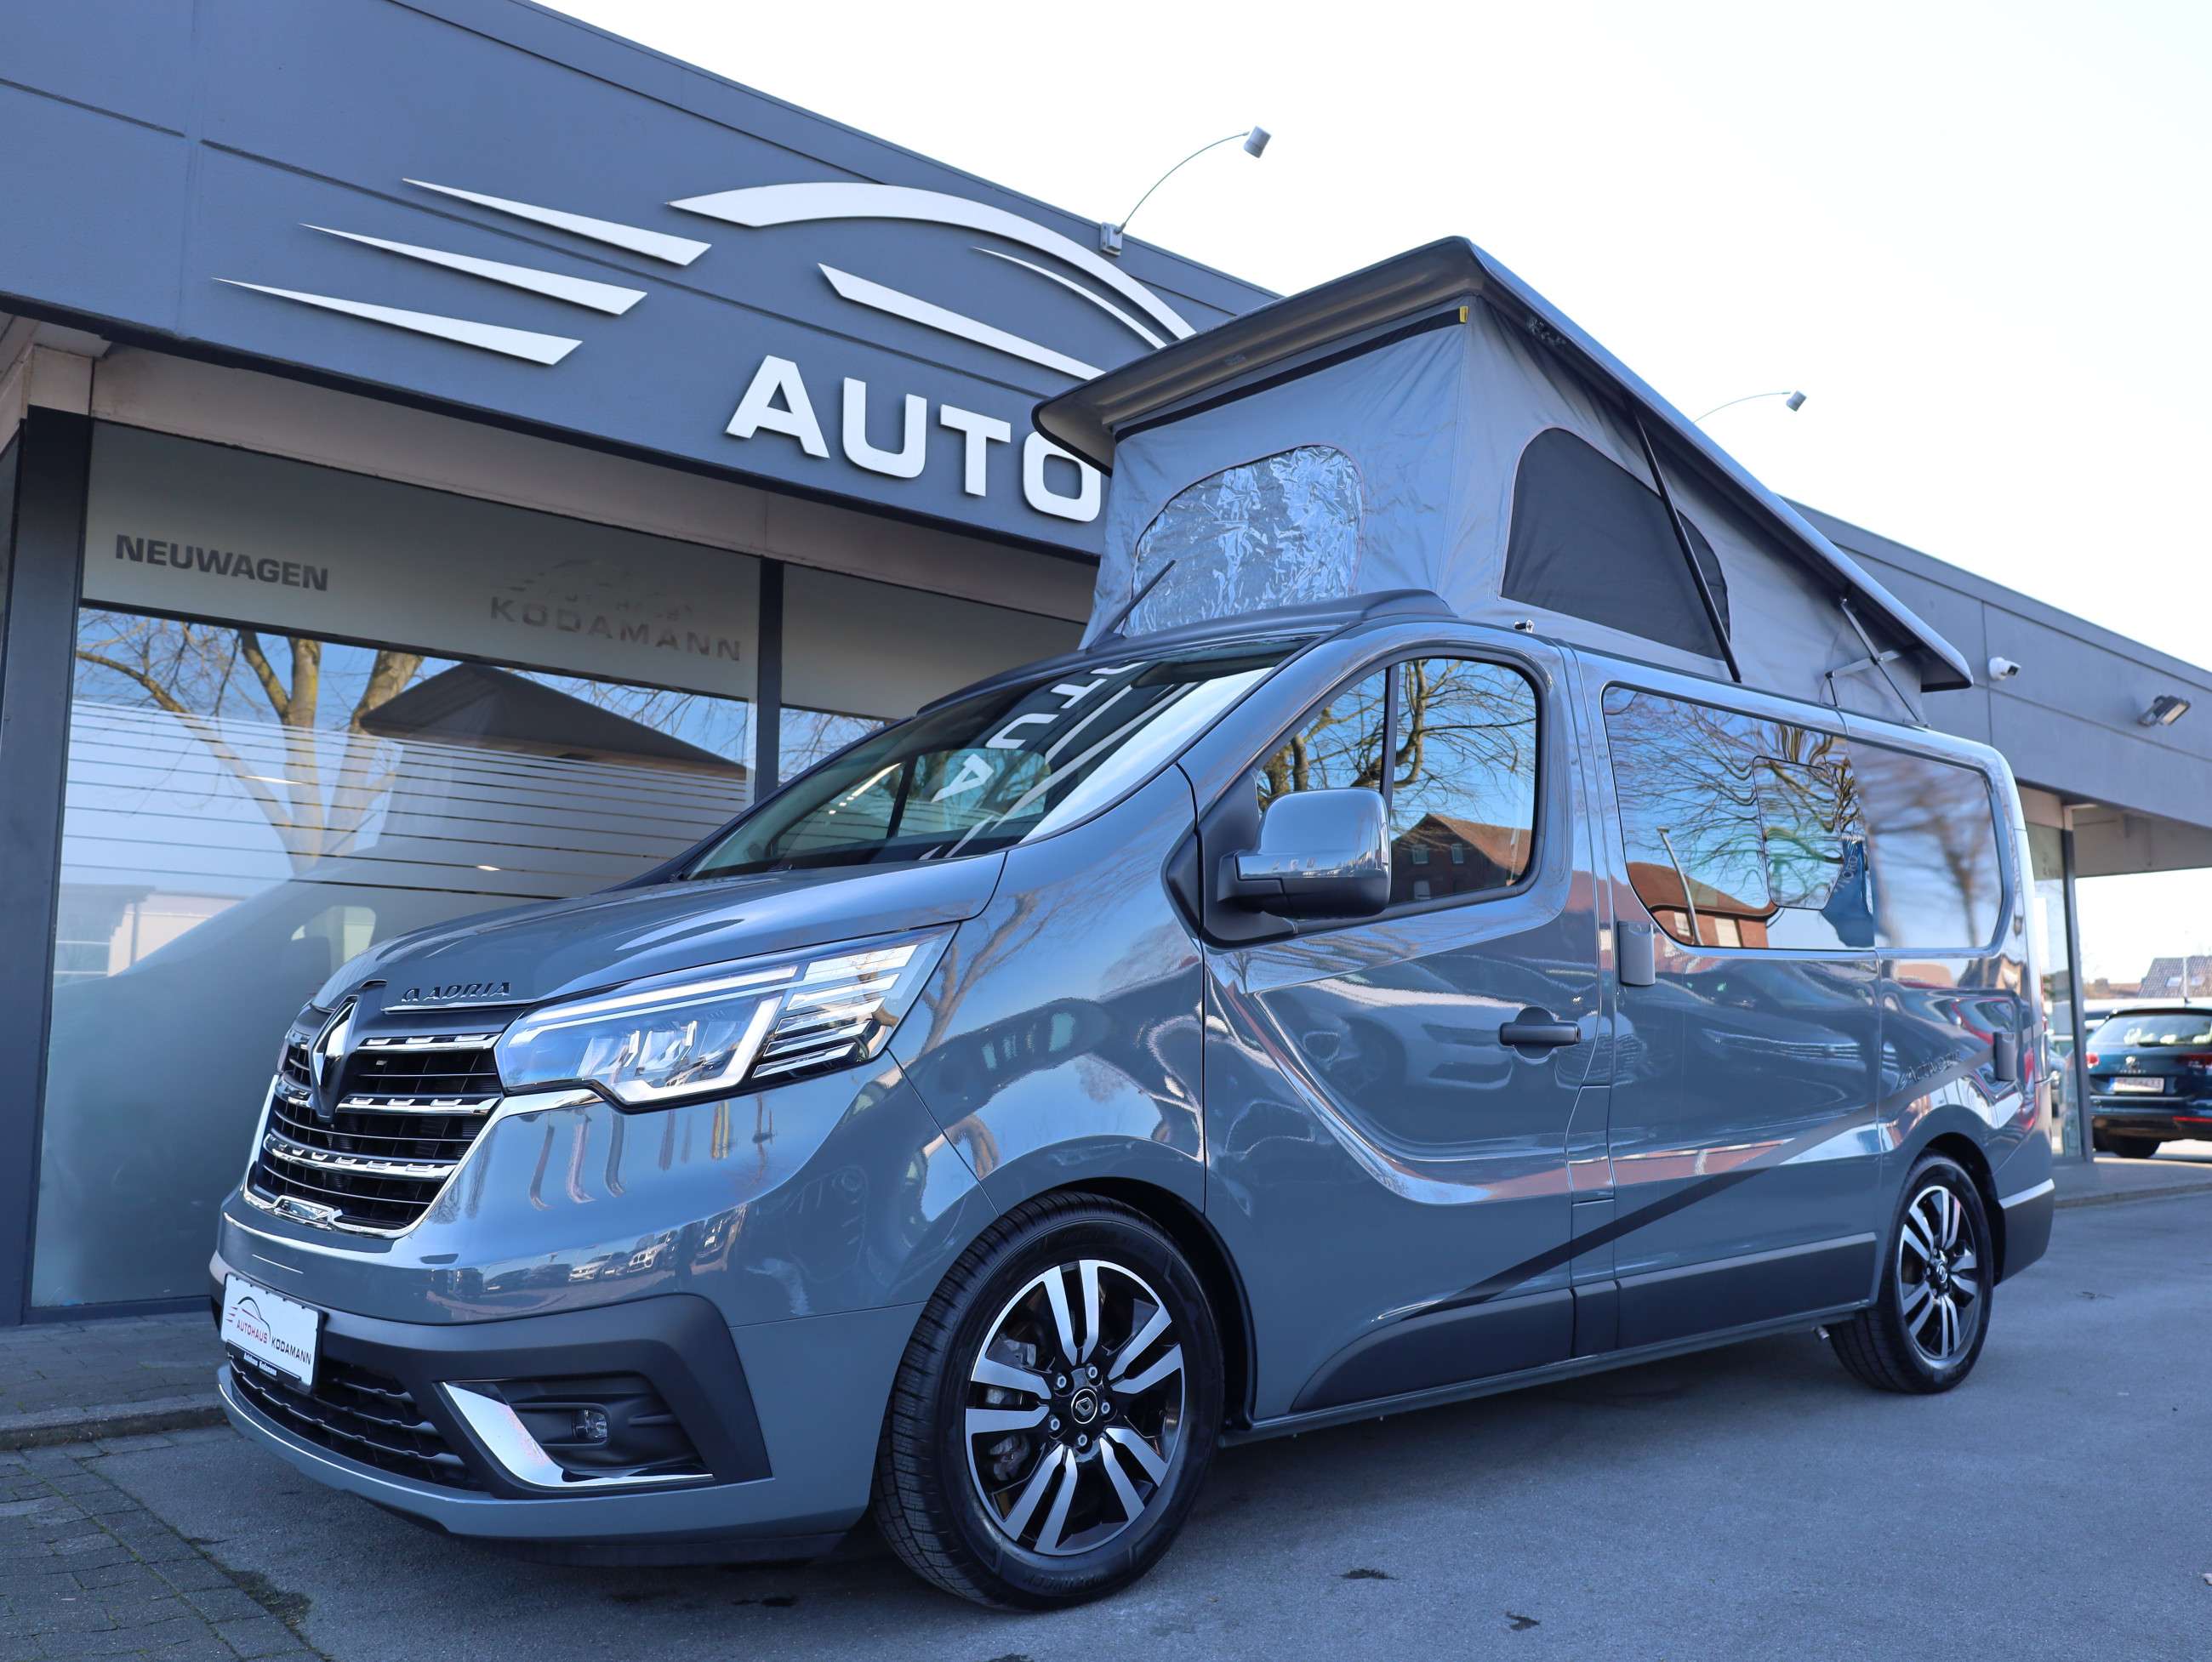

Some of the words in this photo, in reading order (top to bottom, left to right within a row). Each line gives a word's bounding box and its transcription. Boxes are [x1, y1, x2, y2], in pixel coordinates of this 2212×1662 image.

[724, 354, 1102, 522] AUTO
[115, 533, 328, 592] NEUWAGEN
[490, 595, 741, 662] KODAMANN
[423, 982, 510, 1001] ADRIA
[237, 1319, 269, 1344] AUTOHAUS
[271, 1336, 312, 1366] KODAMANN
